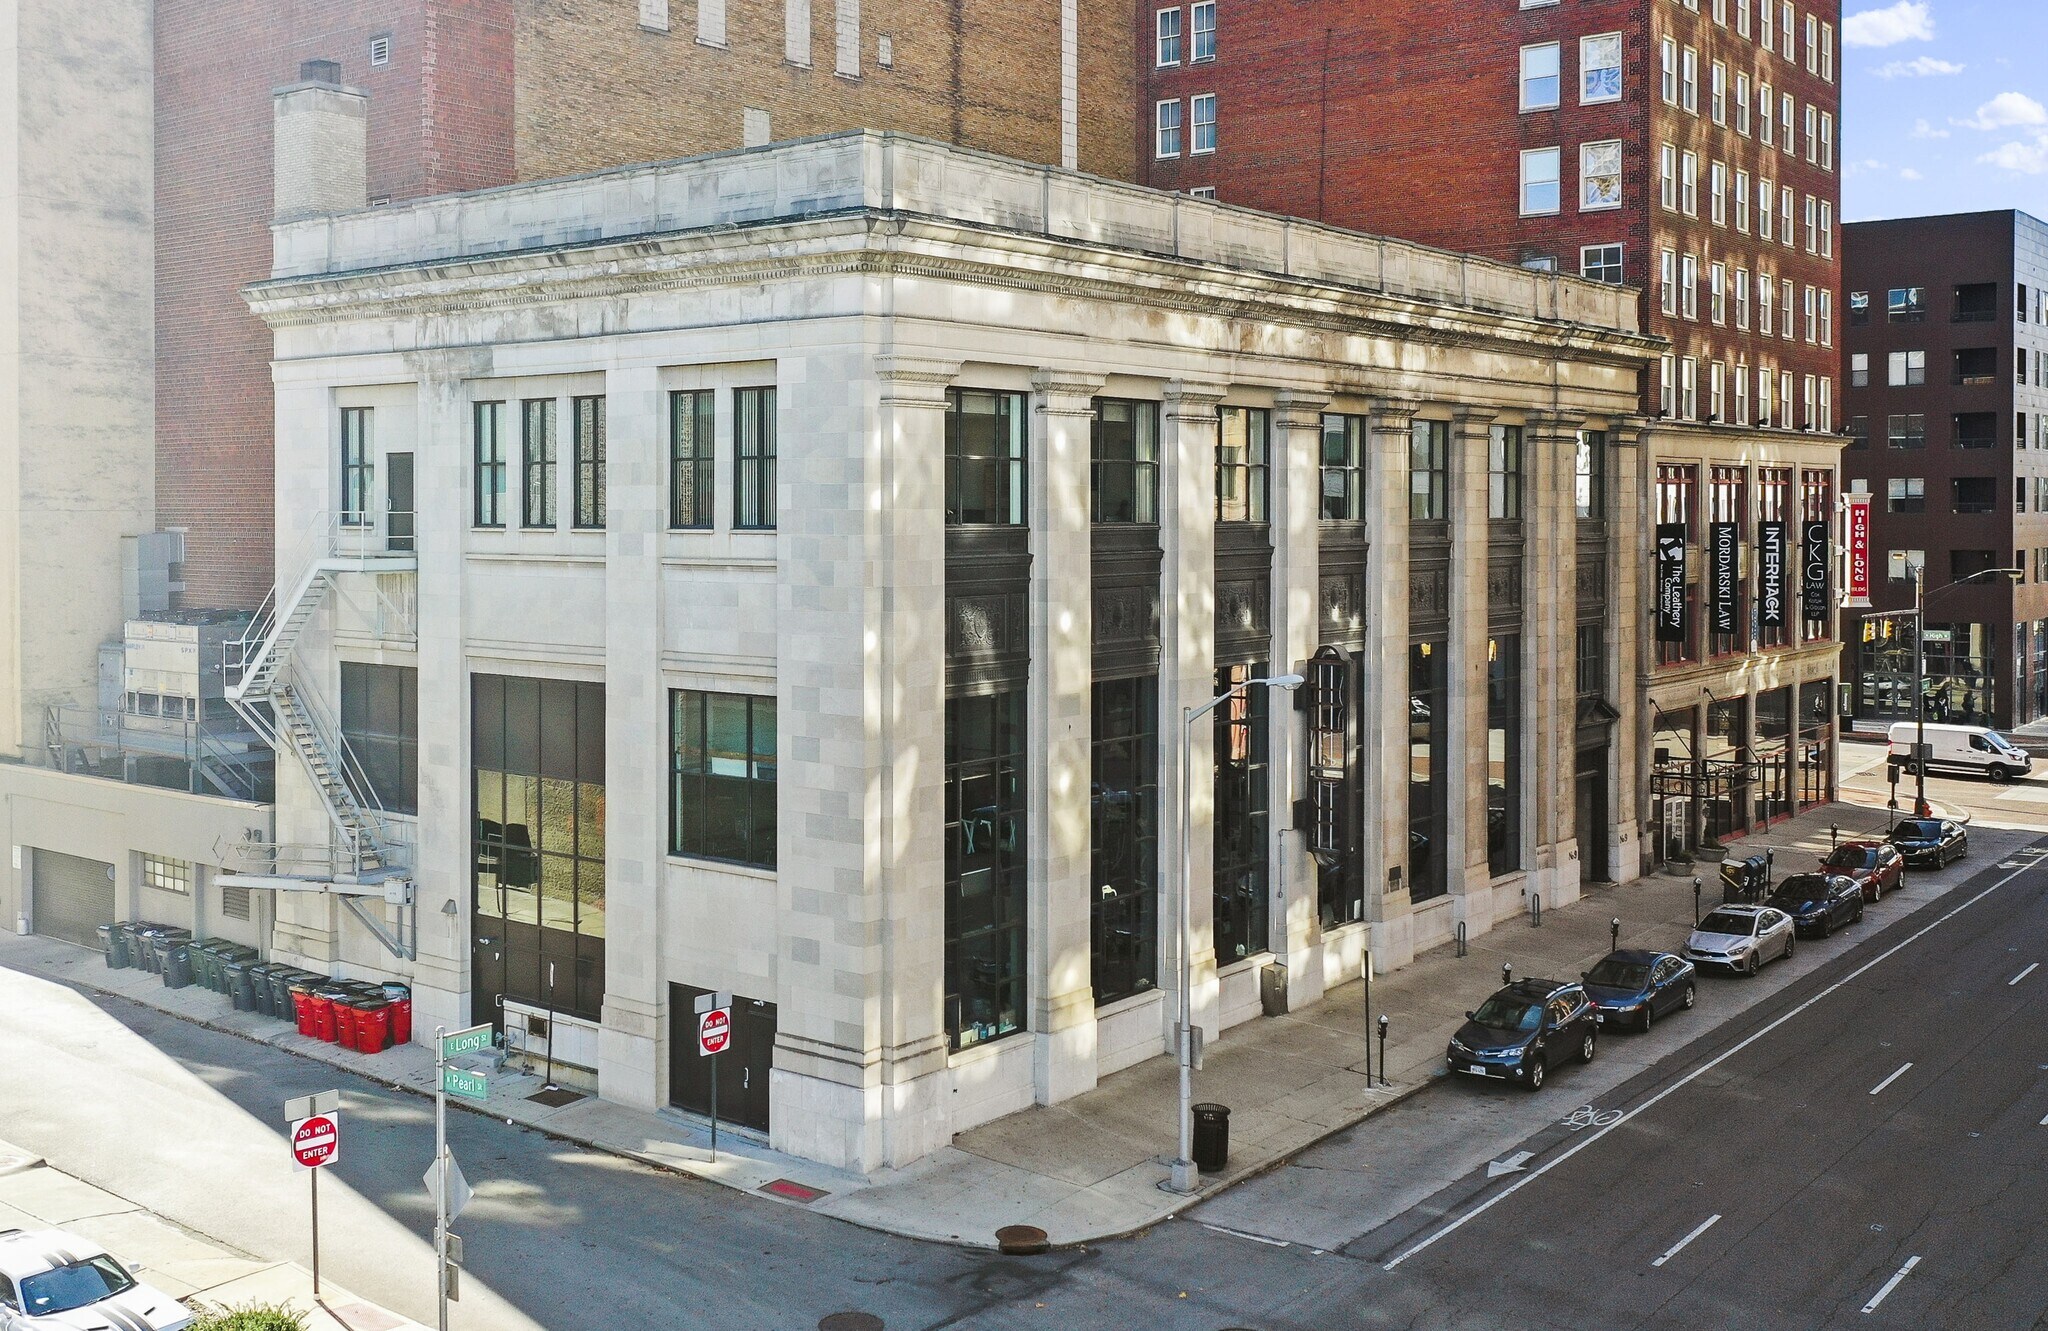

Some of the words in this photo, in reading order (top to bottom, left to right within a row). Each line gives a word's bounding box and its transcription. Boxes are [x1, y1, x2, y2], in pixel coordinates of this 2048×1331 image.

[1854, 509, 1865, 538] HIGH
[1854, 540, 1865, 549] &
[1718, 527, 1732, 599] MORDARSKI
[1854, 553, 1865, 582] LONG
[1672, 564, 1683, 583] The
[1765, 527, 1780, 621] INTERHACK
[1663, 577, 1673, 614] Company
[1670, 586, 1683, 628] Leathery
[1718, 601, 1732, 630] LAW
[705, 1020, 713, 1028] DO
[716, 1017, 726, 1025] NOT
[450, 1042, 454, 1050] E
[455, 1036, 480, 1051] Long
[708, 1036, 723, 1046] ENTER
[453, 1074, 475, 1092] Pearl
[299, 1128, 311, 1139] DO
[315, 1123, 331, 1135] NOT
[302, 1146, 328, 1160] ENTER
